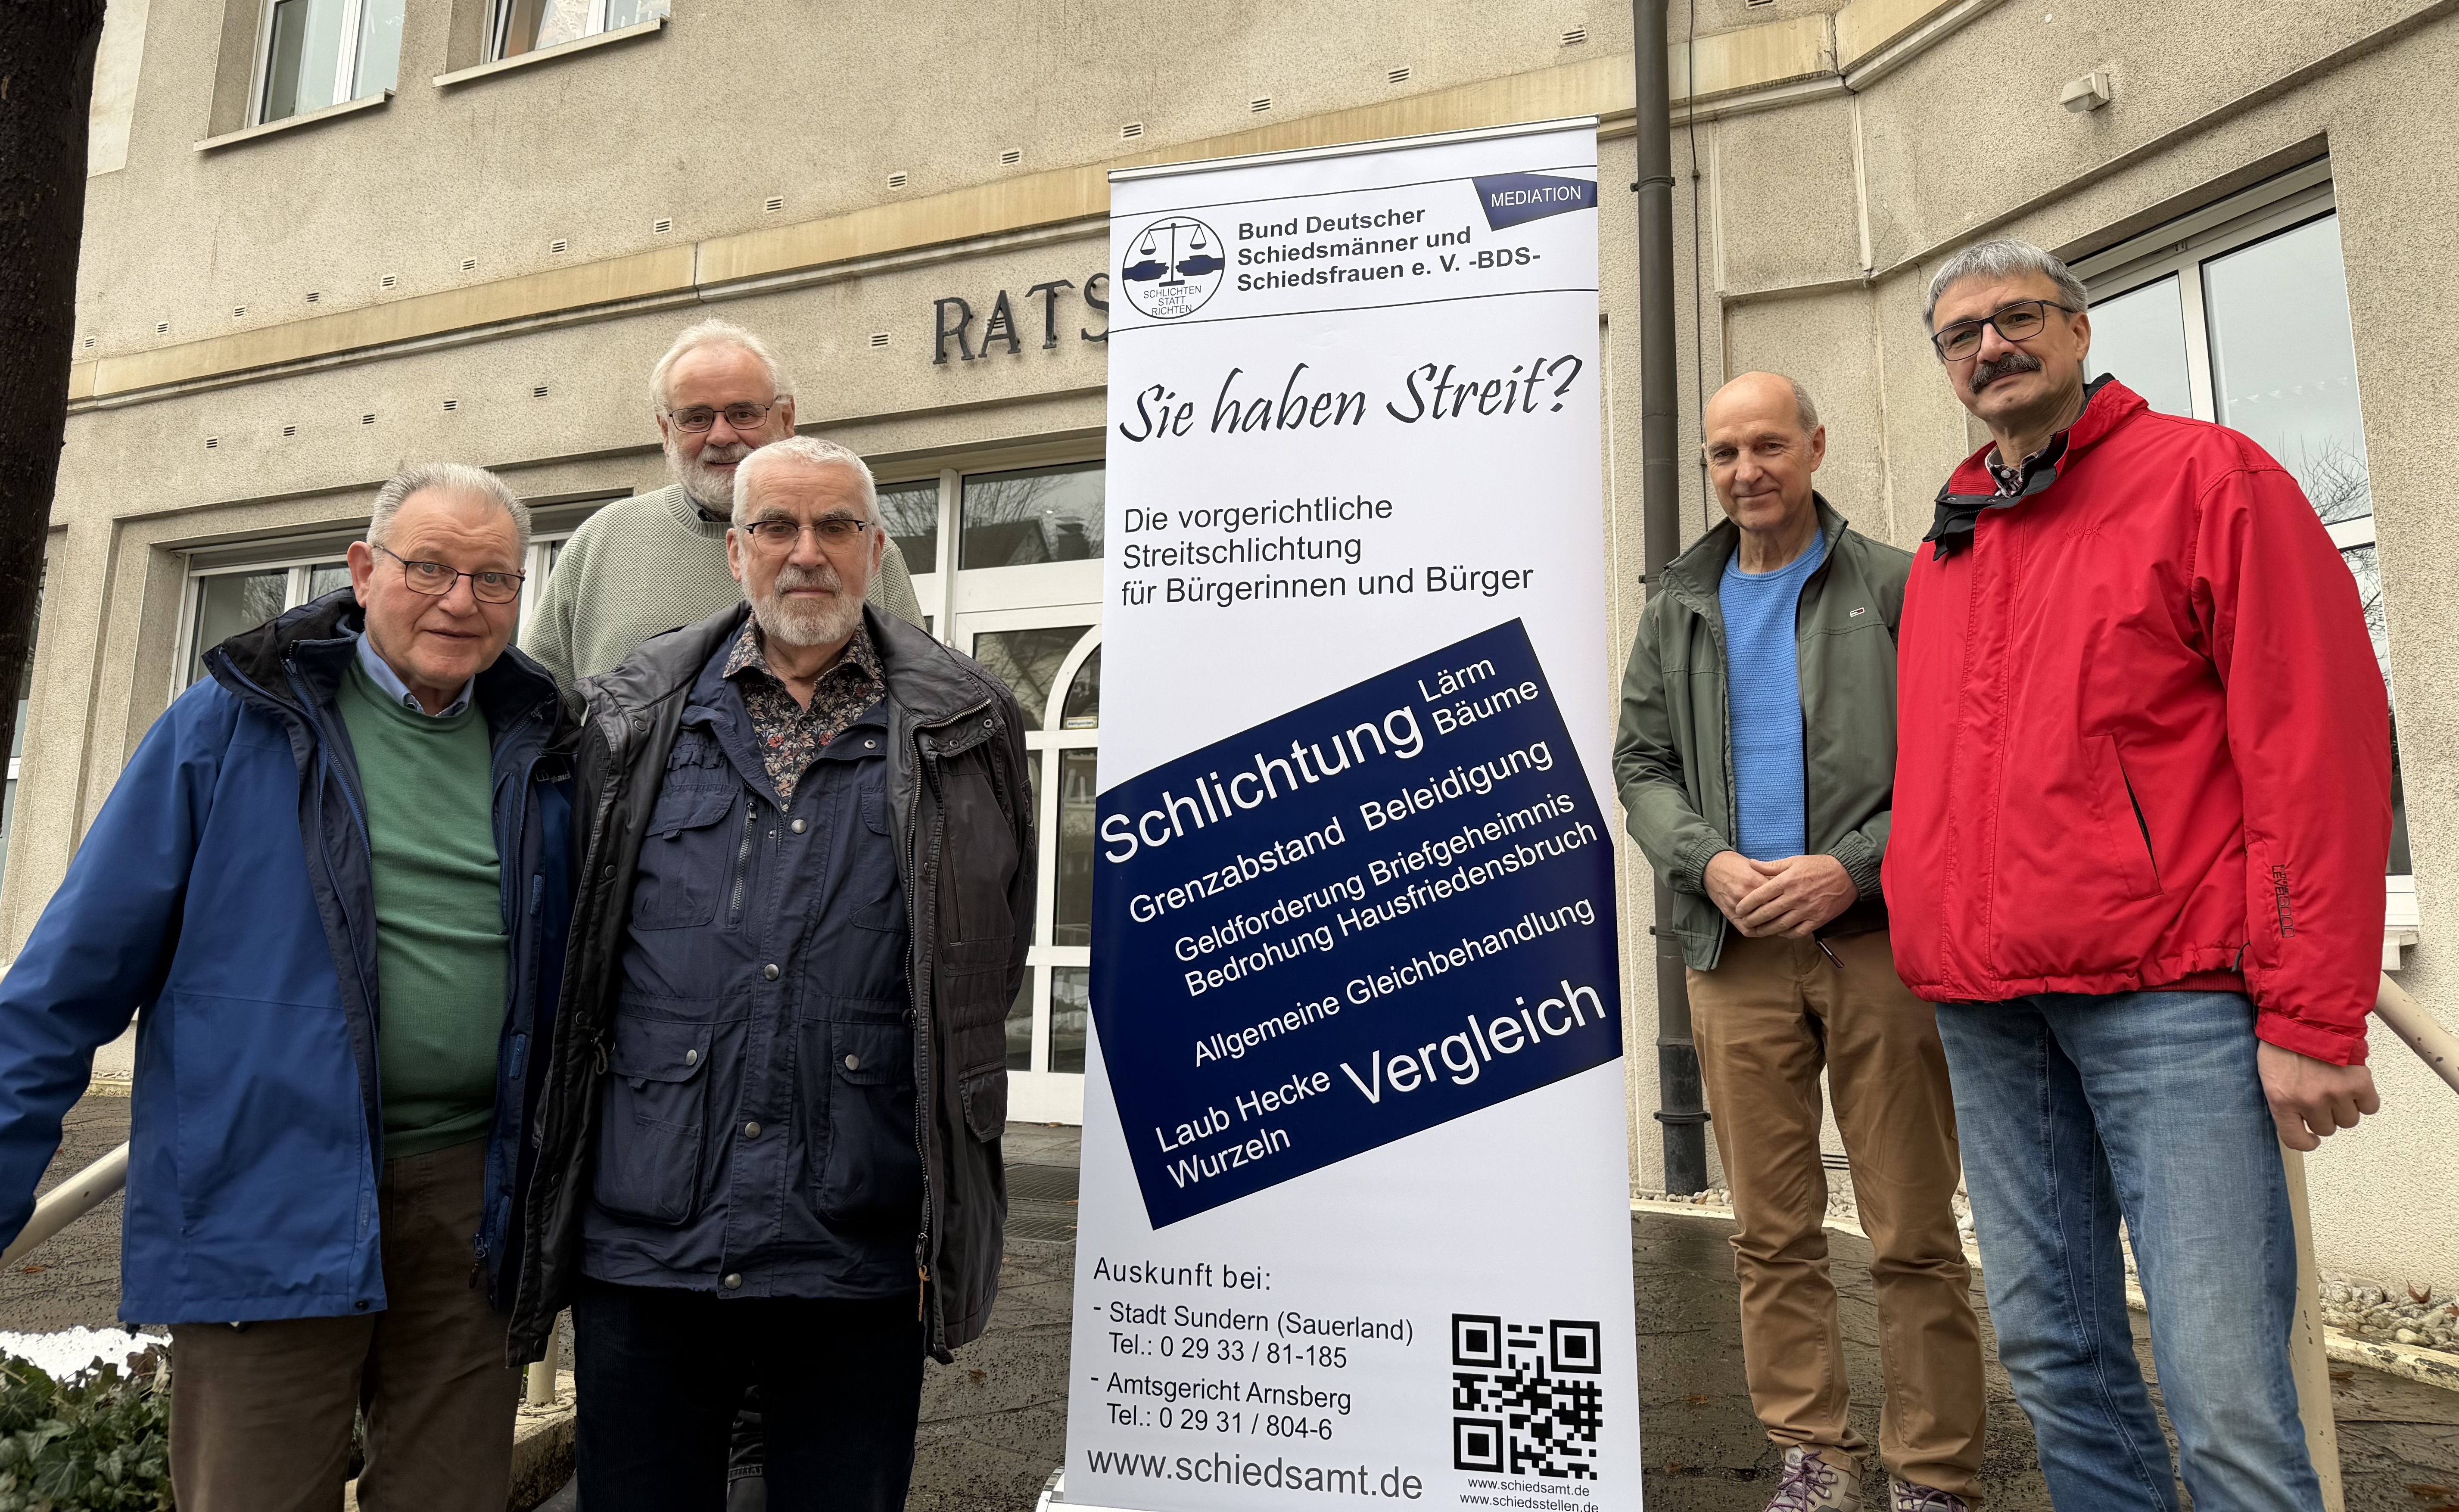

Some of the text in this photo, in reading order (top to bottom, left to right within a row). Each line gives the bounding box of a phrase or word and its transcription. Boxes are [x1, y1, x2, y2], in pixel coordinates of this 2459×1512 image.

[1491, 185, 1581, 208] MEDIATION
[1238, 226, 1470, 265] Schiedsmänner und
[1239, 209, 1426, 240] Bund Deutscher
[1237, 247, 1540, 291] Schiedsfrauen e. V. -BDS-
[1143, 285, 1201, 299] SCHLICHTEN
[1152, 304, 1192, 316] RICHTEN
[1158, 296, 1186, 306] STATT
[933, 273, 1109, 364] RATS
[1119, 355, 1583, 442] Sie haben Streit?
[1125, 495, 1392, 533] Die vorgerichtliche
[1124, 536, 1361, 569] Streitschlichtung
[1121, 565, 1534, 607] für Bürgerinnen und Bürger
[1418, 660, 1496, 702] Lärm
[1432, 681, 1538, 735] Bäume
[1101, 706, 1424, 863] Schlichtung
[1130, 741, 1553, 922] Grenzabstand Beleidigung
[1175, 794, 1574, 961] Geldforderung Briefgeheimnis
[1185, 821, 1597, 996] Bedrohung Hausfriedensbruch
[1196, 899, 1595, 1067] Allgemeine Gleichbehandlung
[1339, 980, 1606, 1104] Vergleich
[1155, 1072, 1330, 1153] Laub Hecke
[1166, 1129, 1291, 1188] Wurzeln
[1093, 1257, 1270, 1290] Auskunft bei:
[1110, 1301, 1167, 1325] Stadt
[1174, 1305, 1268, 1331] Sundern
[1278, 1311, 1413, 1347] (Sauerland)
[1108, 1332, 1347, 1368] Tel.: 0 29 33 / 81-185
[1106, 1372, 1240, 1403] Amtsgericht
[1245, 1381, 1351, 1415] Arnsberg
[1107, 1403, 1332, 1440] Tel.: 0 29 31 / 804-6
[1087, 1450, 1422, 1499] www.schiedsamt.de
[1468, 1479, 1590, 1496] www.schiedsamt.de
[1460, 1494, 1599, 1512] www.schiedsstellen.de
